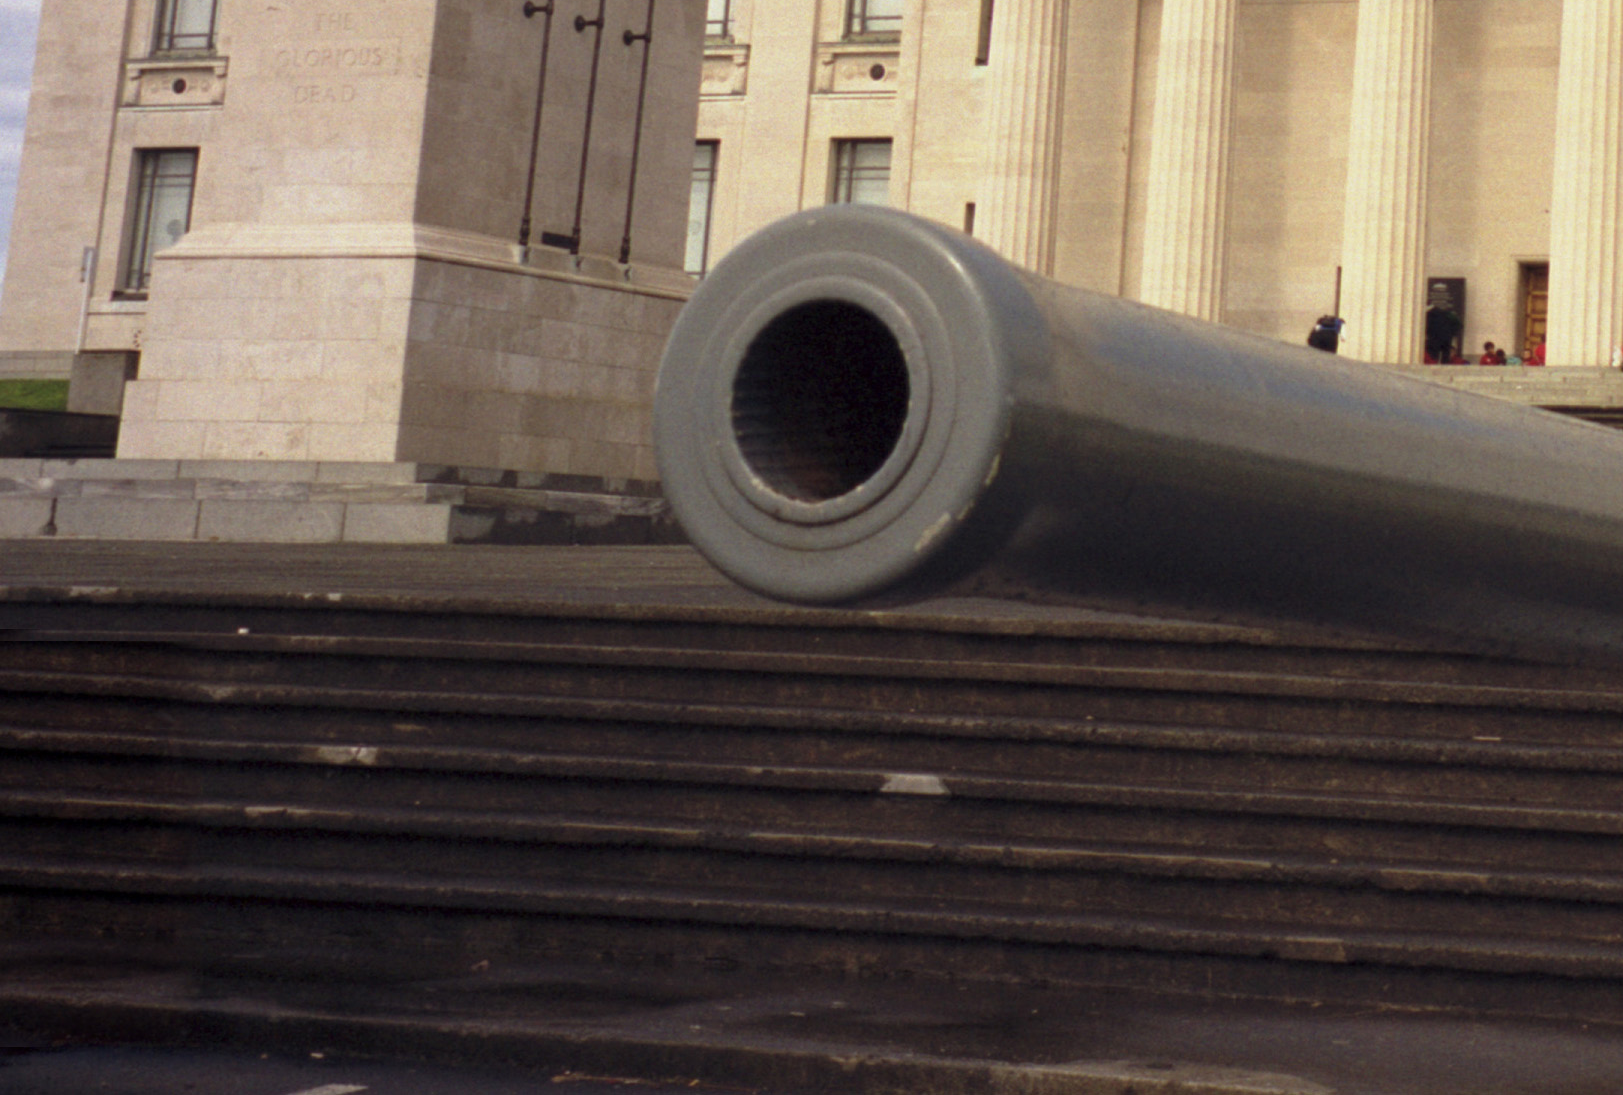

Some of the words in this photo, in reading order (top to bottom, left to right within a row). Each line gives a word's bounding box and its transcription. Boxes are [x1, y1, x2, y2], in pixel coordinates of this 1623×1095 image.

[315, 12, 353, 31] THE
[276, 47, 383, 67] GLORIOUS
[294, 85, 357, 104] DEAD
